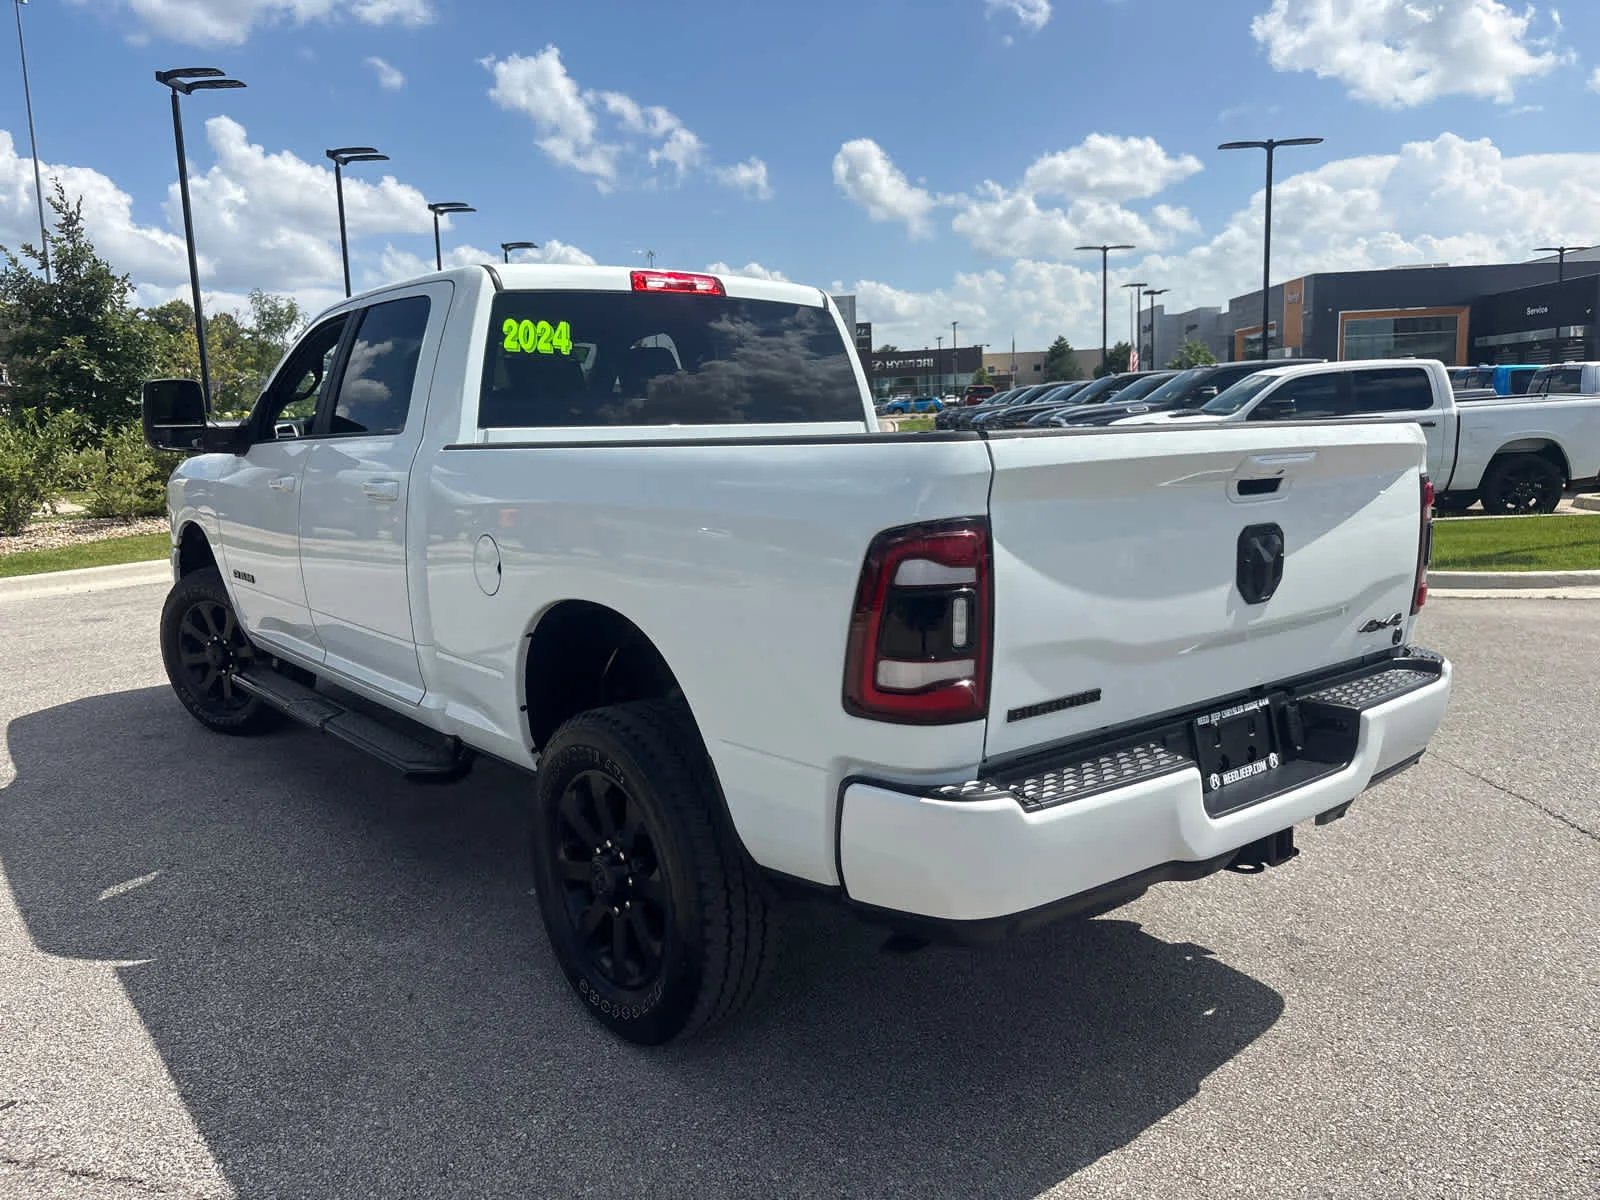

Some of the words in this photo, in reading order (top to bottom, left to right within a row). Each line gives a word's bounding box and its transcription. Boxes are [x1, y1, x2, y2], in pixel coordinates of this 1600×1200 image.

[1526, 306, 1548, 316] Service
[502, 318, 573, 355] 2024
[886, 358, 934, 369] HYUNDAI
[1222, 760, 1267, 785] REEDJEEP.COM
